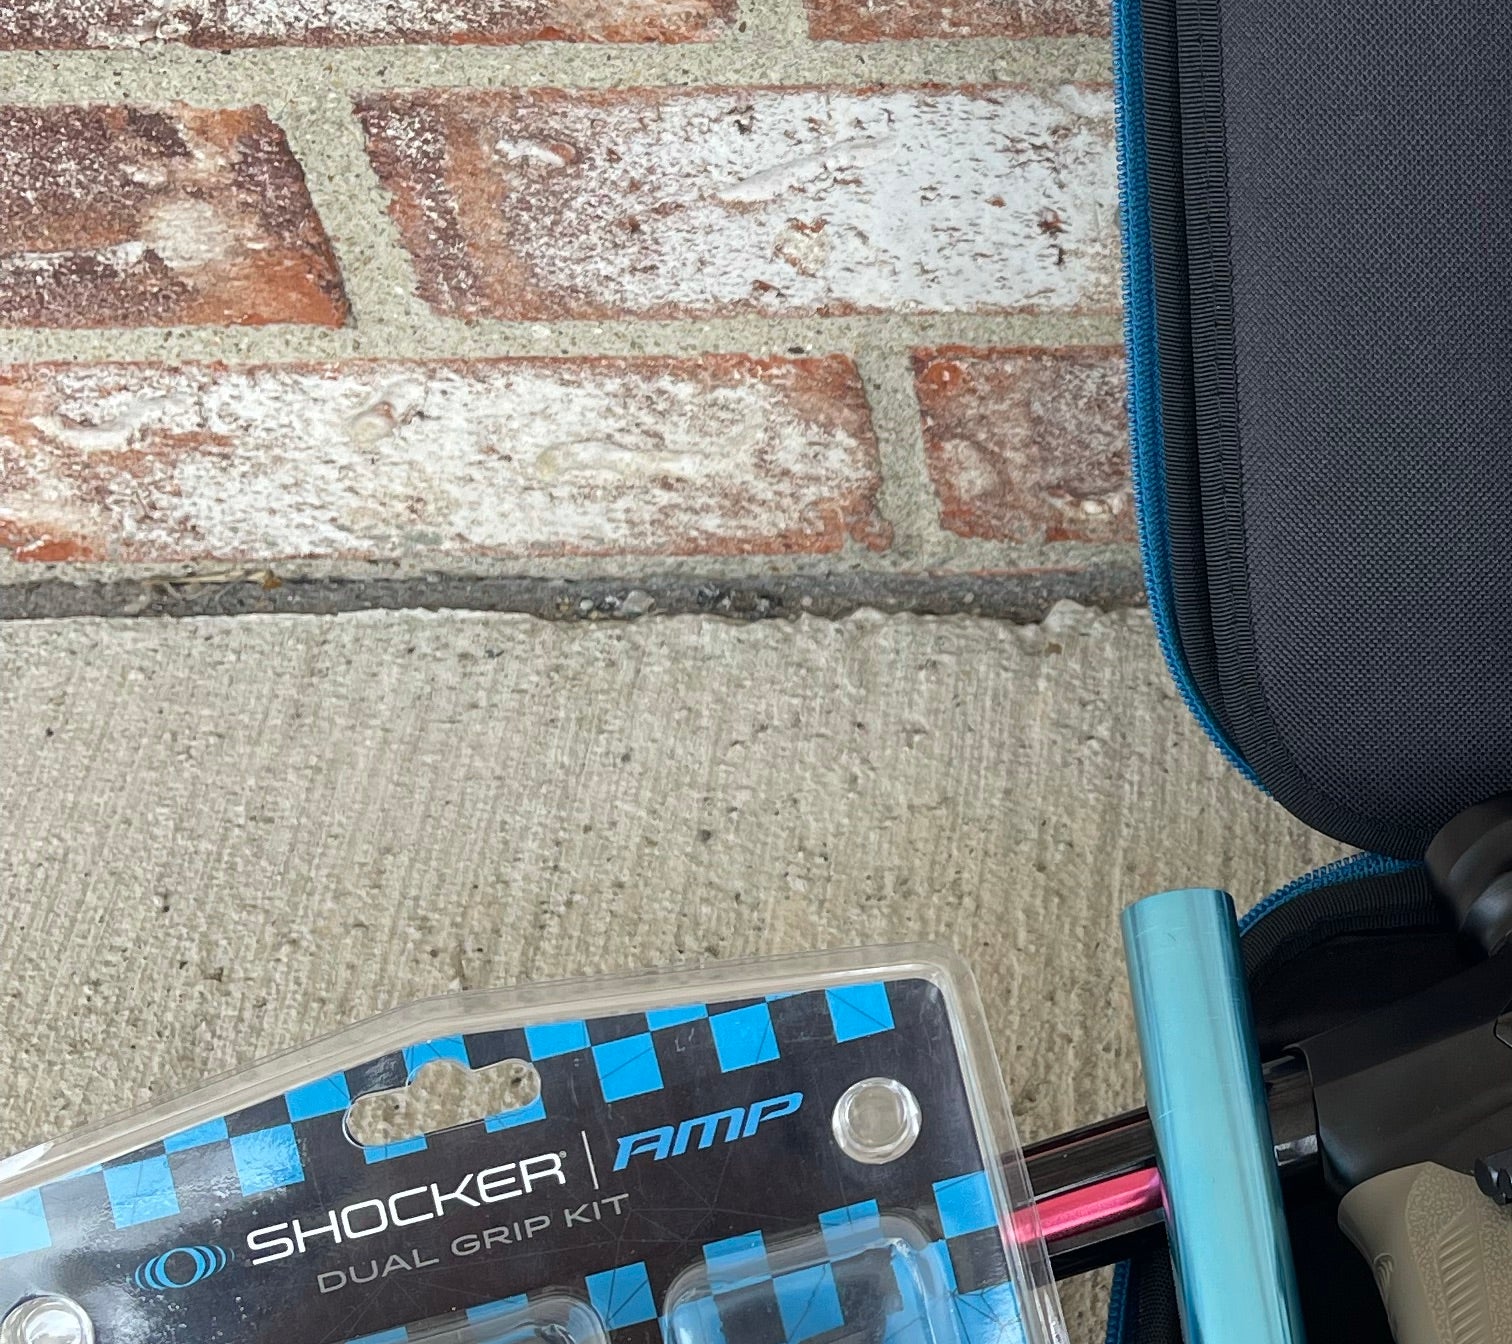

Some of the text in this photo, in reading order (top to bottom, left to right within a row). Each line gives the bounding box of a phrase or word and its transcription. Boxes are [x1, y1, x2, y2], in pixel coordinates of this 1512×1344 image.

[613, 1092, 804, 1173] AMP
[317, 1194, 630, 1293] DUAL GRIP KIT
